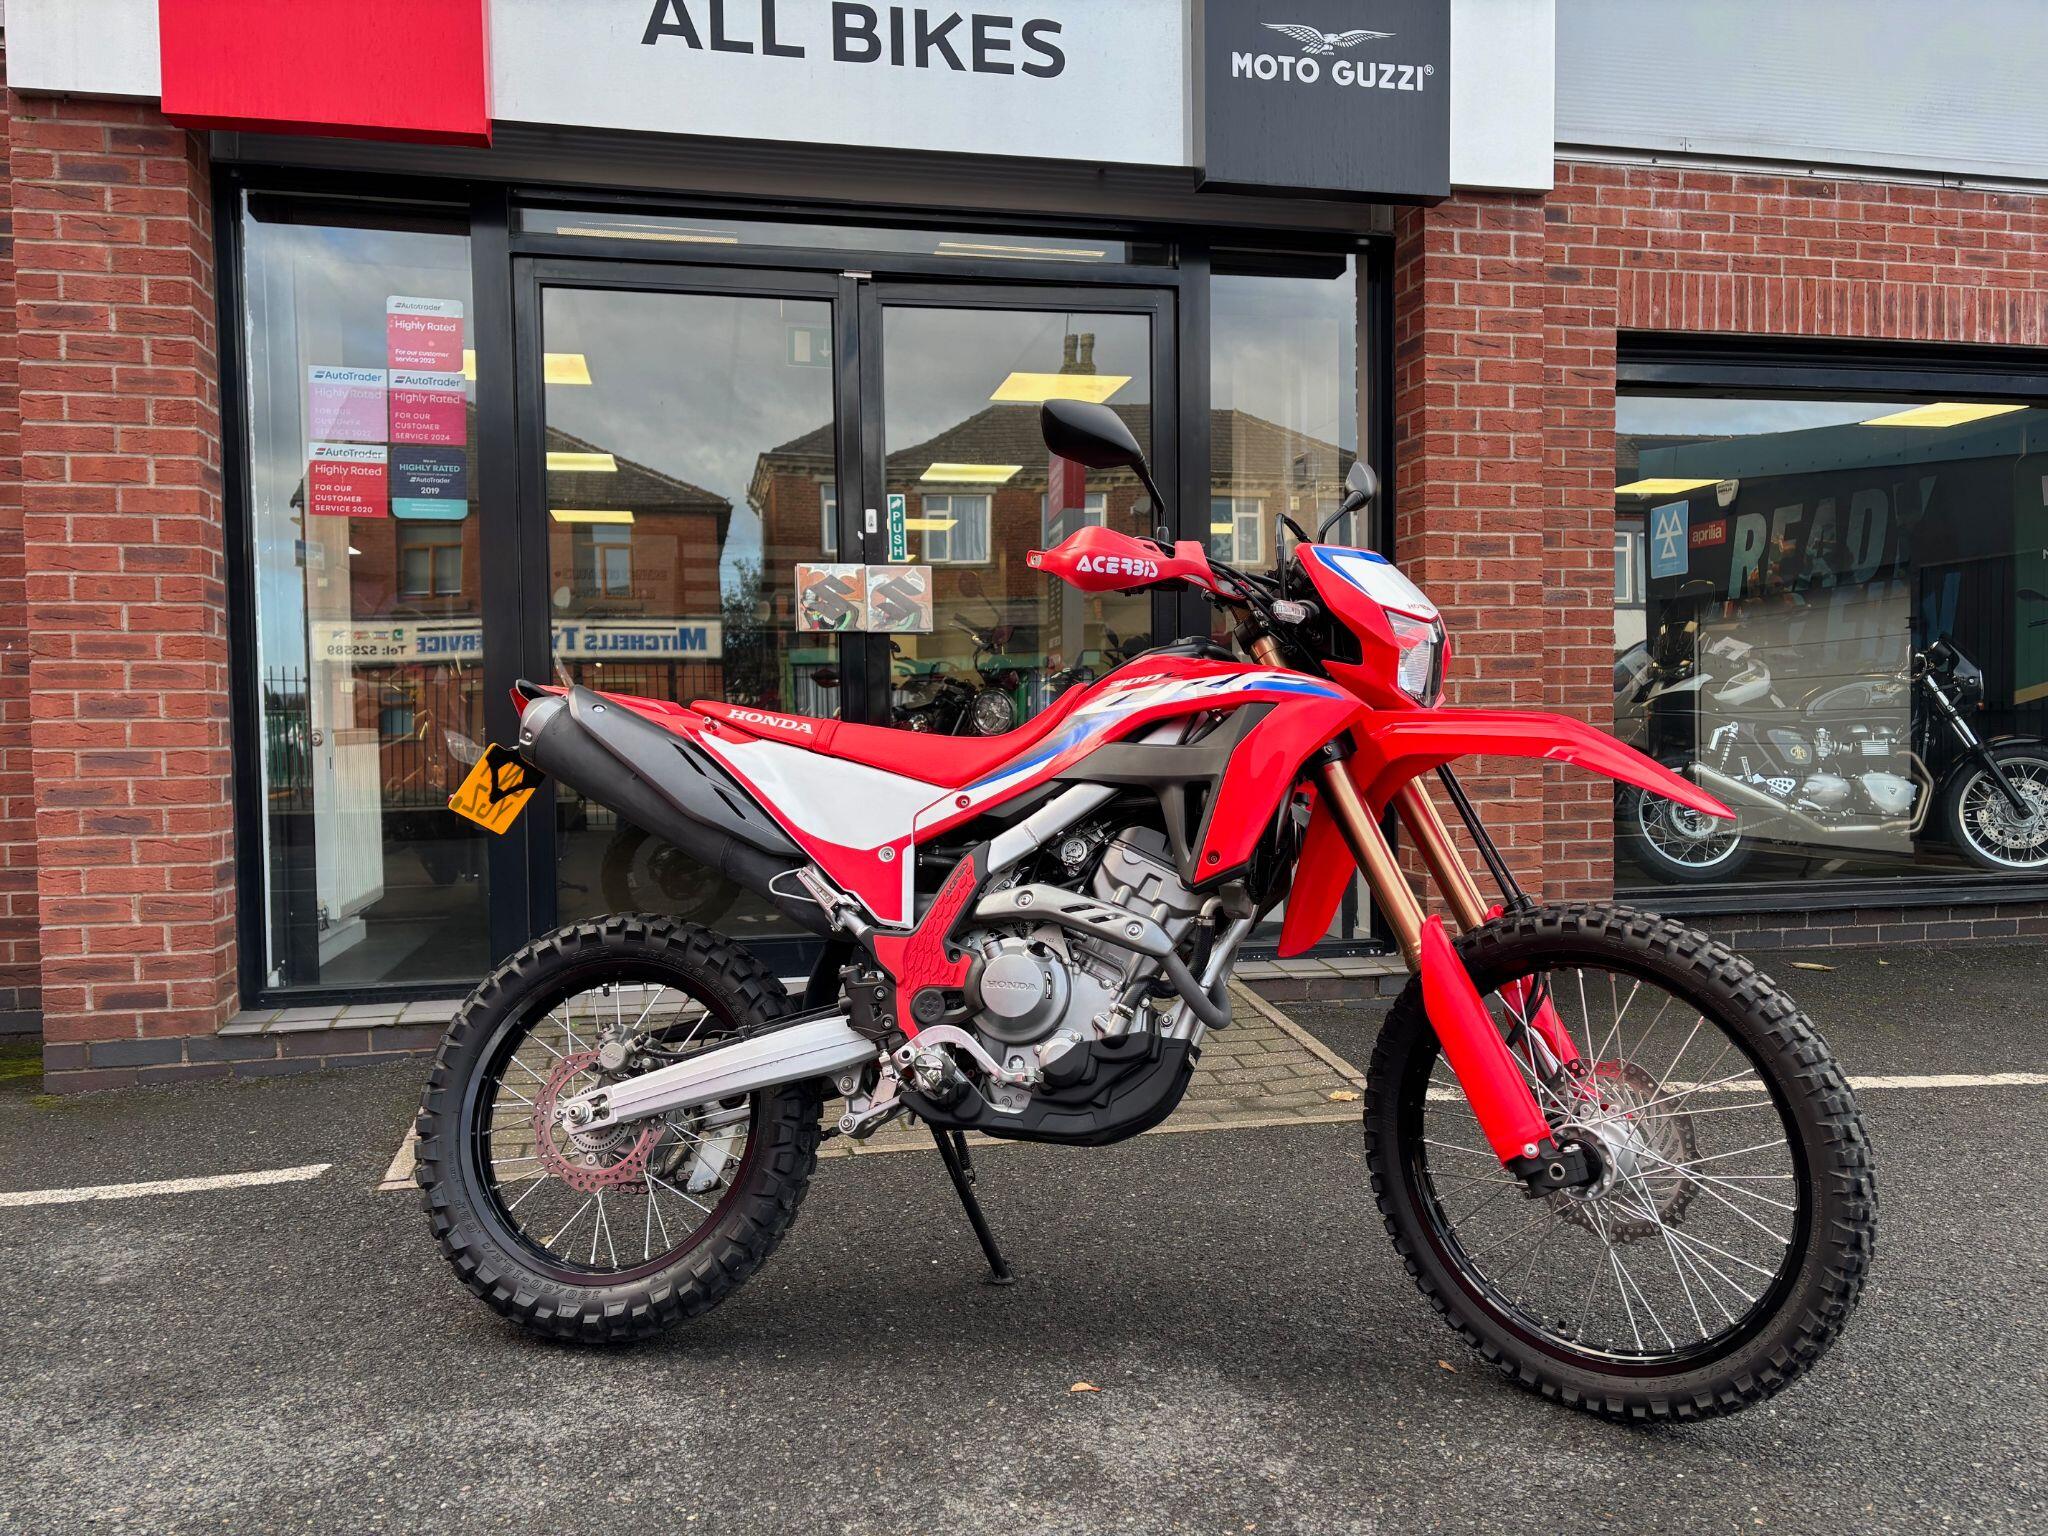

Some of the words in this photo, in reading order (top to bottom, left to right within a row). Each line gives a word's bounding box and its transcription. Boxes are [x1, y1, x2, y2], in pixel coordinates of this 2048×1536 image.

[641, 0, 806, 59] ALL
[832, 1, 1066, 79] BIKES
[1231, 51, 1320, 84] MOTO
[395, 320, 425, 332] Highly
[427, 322, 456, 332] Rated
[325, 371, 382, 382] AutoTrader
[405, 376, 460, 387] AutoTrader
[394, 392, 428, 404] Highly
[429, 394, 460, 404] Rated
[394, 422, 440, 431] CUSTOMER
[395, 432, 429, 440] SERVICE
[325, 447, 384, 459] AutoTrader
[315, 464, 349, 476] Highly
[350, 466, 382, 476] Rated
[399, 463, 431, 472] HIGHLY
[432, 464, 460, 473] RATED
[333, 484, 352, 492] OUR
[420, 486, 440, 495] 2019
[314, 494, 362, 503] CUSTOMER
[315, 504, 350, 512] SERVICE
[893, 511, 903, 556] PUSH
[1692, 524, 1722, 544] aprilia
[1076, 554, 1159, 578] ACERBIS
[727, 709, 813, 734] HONDA
[986, 980, 1039, 991] HONDA
